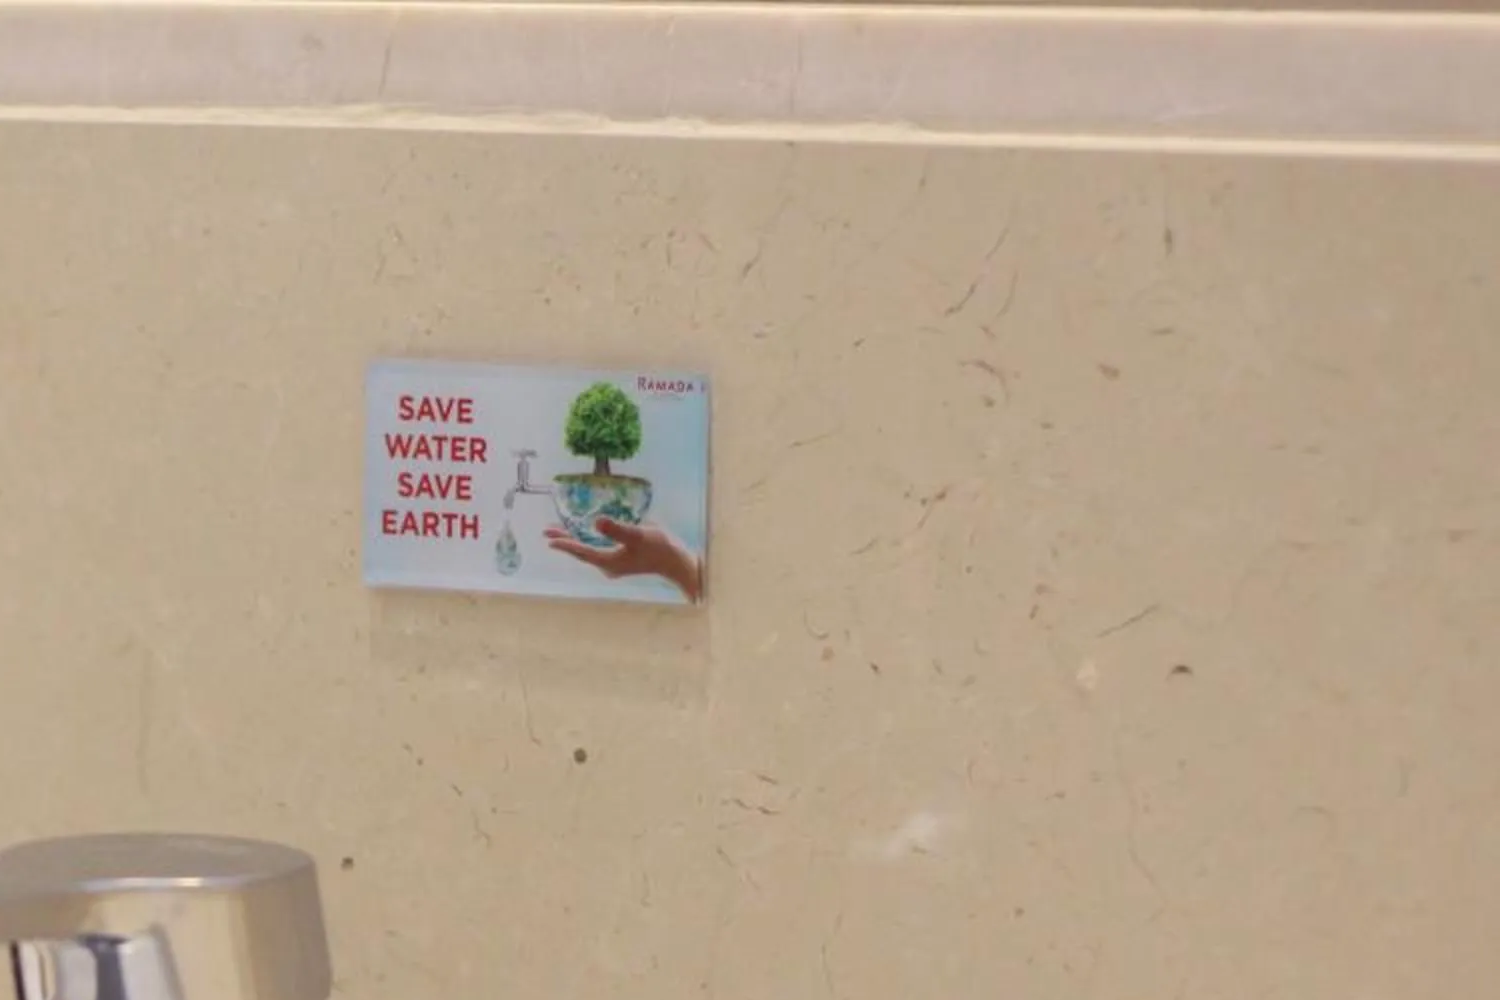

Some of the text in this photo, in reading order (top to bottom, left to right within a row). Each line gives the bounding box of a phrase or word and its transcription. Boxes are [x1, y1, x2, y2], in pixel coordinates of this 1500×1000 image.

[637, 376, 694, 393] RAMADA
[398, 395, 474, 424] SAVE
[384, 433, 487, 463] WATER
[396, 472, 473, 501] SAVE
[381, 509, 479, 540] EARTH
